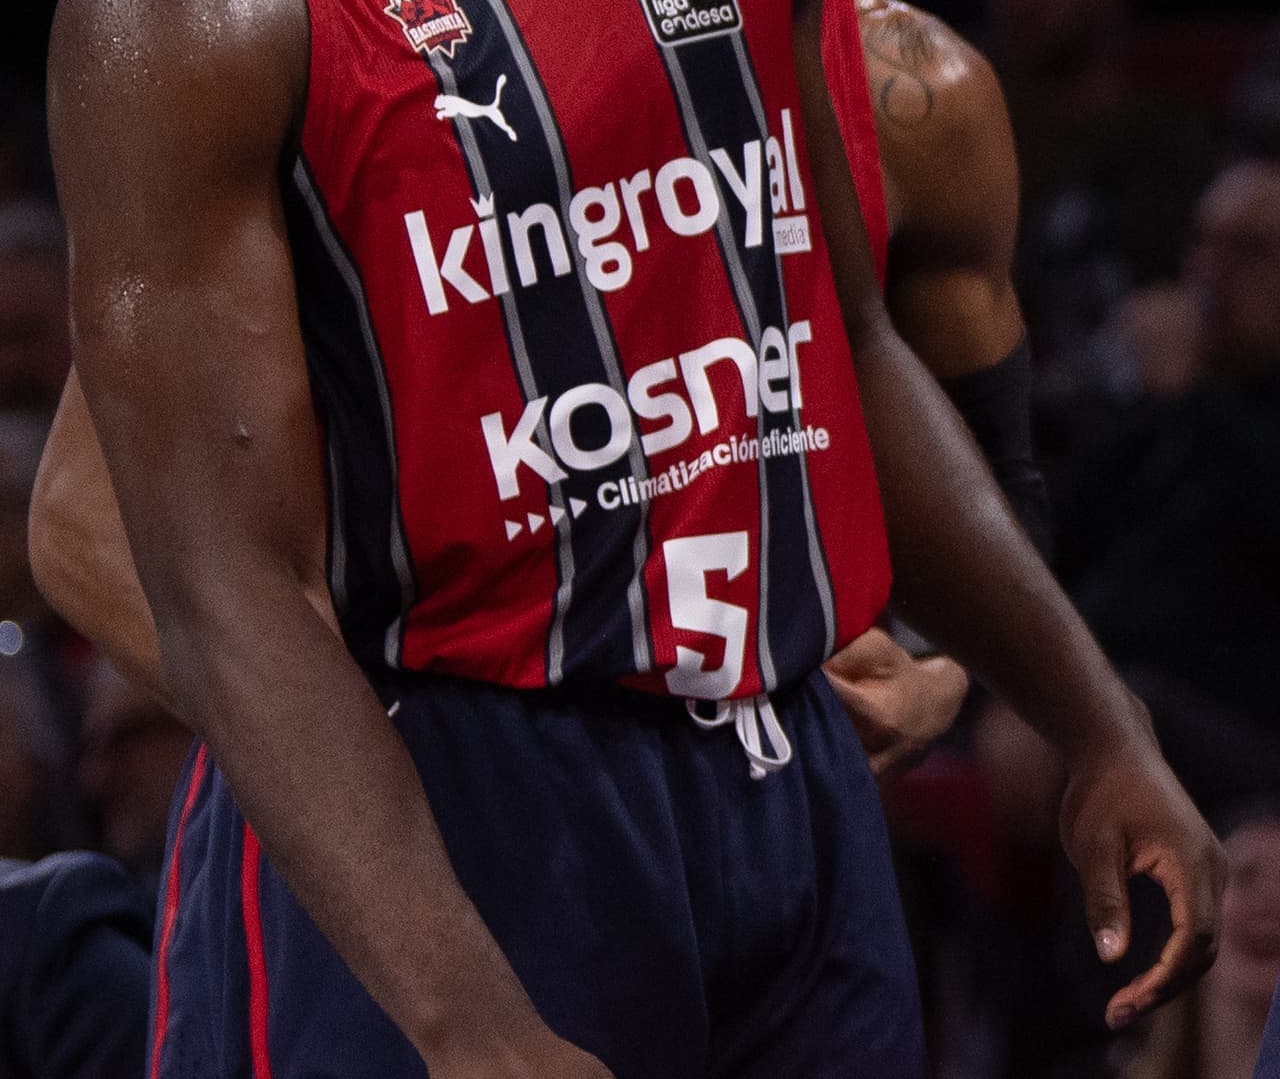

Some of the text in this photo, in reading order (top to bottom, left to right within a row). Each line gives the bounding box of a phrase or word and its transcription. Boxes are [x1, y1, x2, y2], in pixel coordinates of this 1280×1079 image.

[408, 12, 467, 46] BASKONIA
[660, 4, 735, 35] endesa
[403, 107, 806, 316] kingroyal
[597, 424, 830, 510] Climatización eficiente
[662, 530, 749, 701] 5
